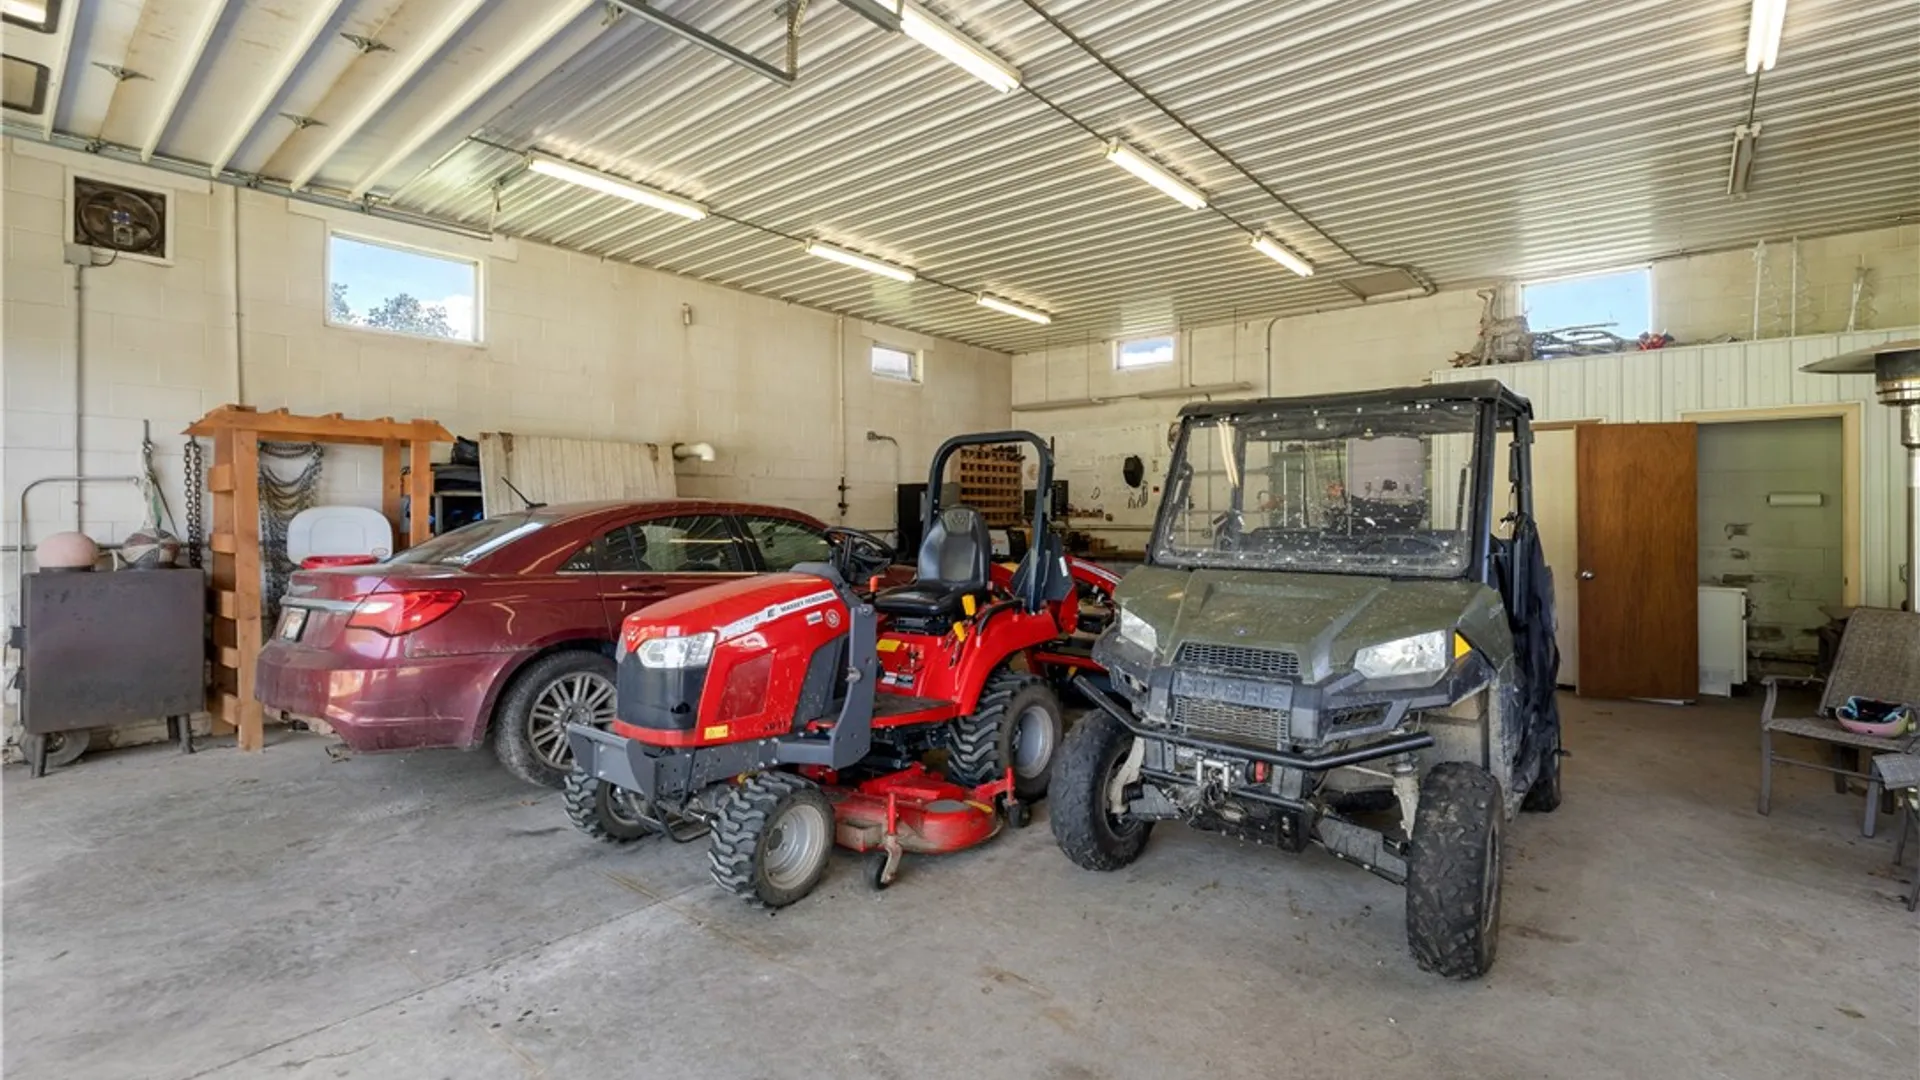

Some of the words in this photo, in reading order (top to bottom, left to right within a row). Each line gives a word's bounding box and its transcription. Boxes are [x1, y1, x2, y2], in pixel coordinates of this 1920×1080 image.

[780, 601, 803, 612] MASSEY
[804, 592, 834, 604] FERGUSON
[1174, 671, 1285, 703] POLARIS
